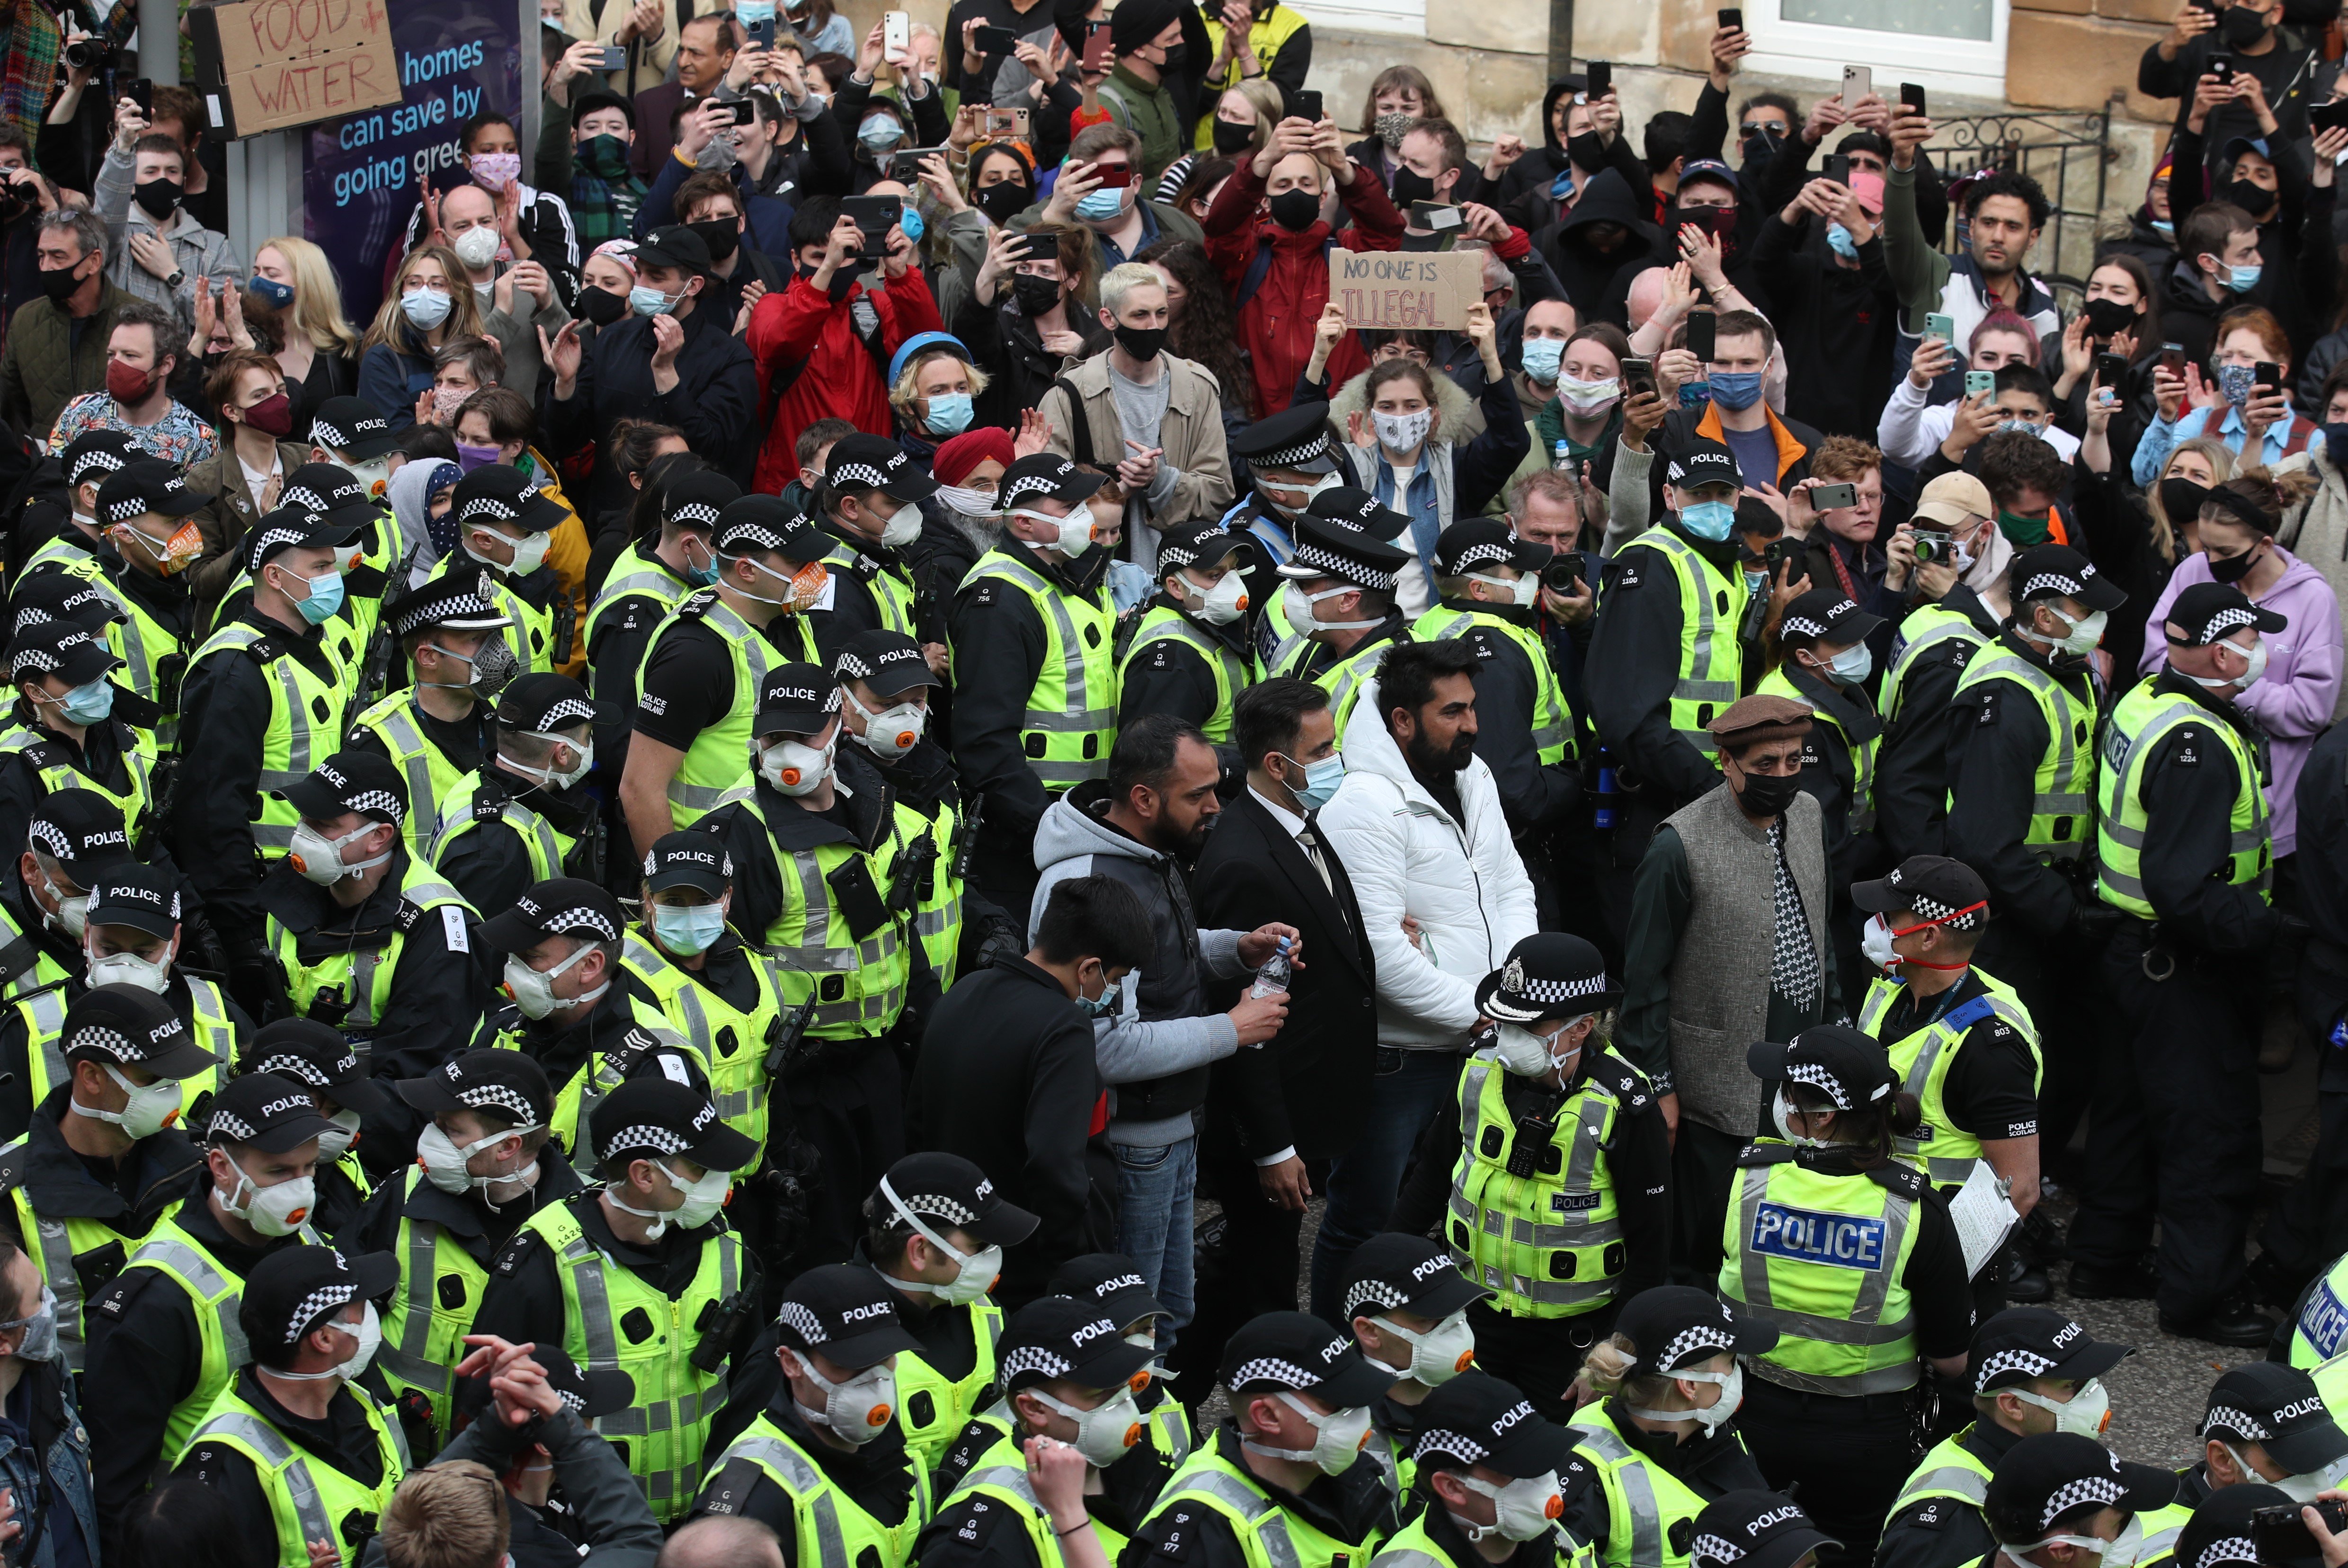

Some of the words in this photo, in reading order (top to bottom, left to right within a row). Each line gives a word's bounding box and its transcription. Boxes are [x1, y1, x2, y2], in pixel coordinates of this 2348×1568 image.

[250, 0, 352, 56] FOOD
[405, 40, 483, 85] homes
[250, 55, 392, 113] WATER
[340, 115, 384, 150] can
[392, 101, 445, 136] save
[453, 85, 481, 118] by
[335, 153, 406, 207] going
[414, 138, 462, 178] gree
[1344, 258, 1370, 279] NO
[1374, 260, 1412, 281] ONE
[1419, 262, 1437, 281] IS
[1341, 289, 1444, 327] ILLEGAL
[355, 417, 388, 433] POLICE
[1690, 454, 1731, 466] POLICE
[1622, 577, 1638, 585] 1100
[62, 590, 99, 611] POLICE
[57, 632, 90, 650] POLIC
[253, 643, 270, 659] 1262
[879, 649, 922, 664] POLICE
[641, 692, 667, 709] POLICE
[768, 687, 816, 701] POLICE
[640, 700, 665, 715] SCOTLAND
[1980, 714, 1991, 722] 577
[25, 748, 42, 765] 2580
[316, 762, 347, 789] OLICE
[476, 807, 498, 815] 3375
[84, 830, 125, 847] POLICE
[667, 851, 715, 865] POLICE
[110, 887, 162, 905] POLICE
[400, 909, 409, 918] G
[403, 909, 420, 930] 1387
[1952, 977, 1963, 993] POLICE
[1975, 1001, 1985, 1009] SP
[1929, 1004, 1945, 1023] SCOTLAND
[1951, 1013, 1963, 1025] 803
[343, 1030, 378, 1041] POLIC
[1994, 1026, 2010, 1037] 803
[337, 1047, 357, 1072] POLI
[621, 1049, 629, 1058] G
[603, 1052, 628, 1071] 2376
[445, 1060, 463, 1082] LICE
[261, 1094, 314, 1117] POLICE
[692, 1101, 716, 1131] POLI
[2008, 1120, 2037, 1132] POLICE
[2009, 1127, 2037, 1137] SCOTLAND
[1741, 1146, 1750, 1158] 935
[2, 1168, 11, 1176] G
[1910, 1174, 1921, 1191] 935
[1555, 1196, 1599, 1210] POLICE
[558, 1224, 566, 1232] G
[516, 1237, 527, 1246] SP
[557, 1226, 583, 1246] 1426
[1758, 1210, 1879, 1262] POLICE
[508, 1253, 515, 1262] G
[1412, 1255, 1453, 1282] POLICE
[1095, 1274, 1145, 1297] POLICE
[115, 1291, 123, 1299] G
[103, 1299, 121, 1313] 1802
[842, 1302, 891, 1325] POLICE
[2304, 1284, 2348, 1353] POLICE
[2052, 1321, 2083, 1349] POLIC
[1321, 1336, 1349, 1363] POLI
[2273, 1396, 2323, 1423] POLICE
[1491, 1400, 1536, 1436] POLICE
[970, 1426, 981, 1436] SP
[200, 1452, 212, 1461] SP
[961, 1447, 969, 1456] Q
[954, 1453, 969, 1467] 1209
[1569, 1462, 1583, 1471] SP
[198, 1471, 205, 1480] G
[1560, 1477, 1569, 1487] Q
[722, 1491, 730, 1499] G
[708, 1501, 732, 1514] 2238
[973, 1503, 988, 1512] SP
[1928, 1505, 1936, 1514] Q
[967, 1519, 977, 1529] G
[1175, 1513, 1189, 1523] SP
[1746, 1506, 1803, 1536] POLICE
[1919, 1513, 1937, 1523] 1330
[958, 1527, 978, 1540] 680
[1170, 1532, 1180, 1541] G
[1164, 1542, 1180, 1553] 177
